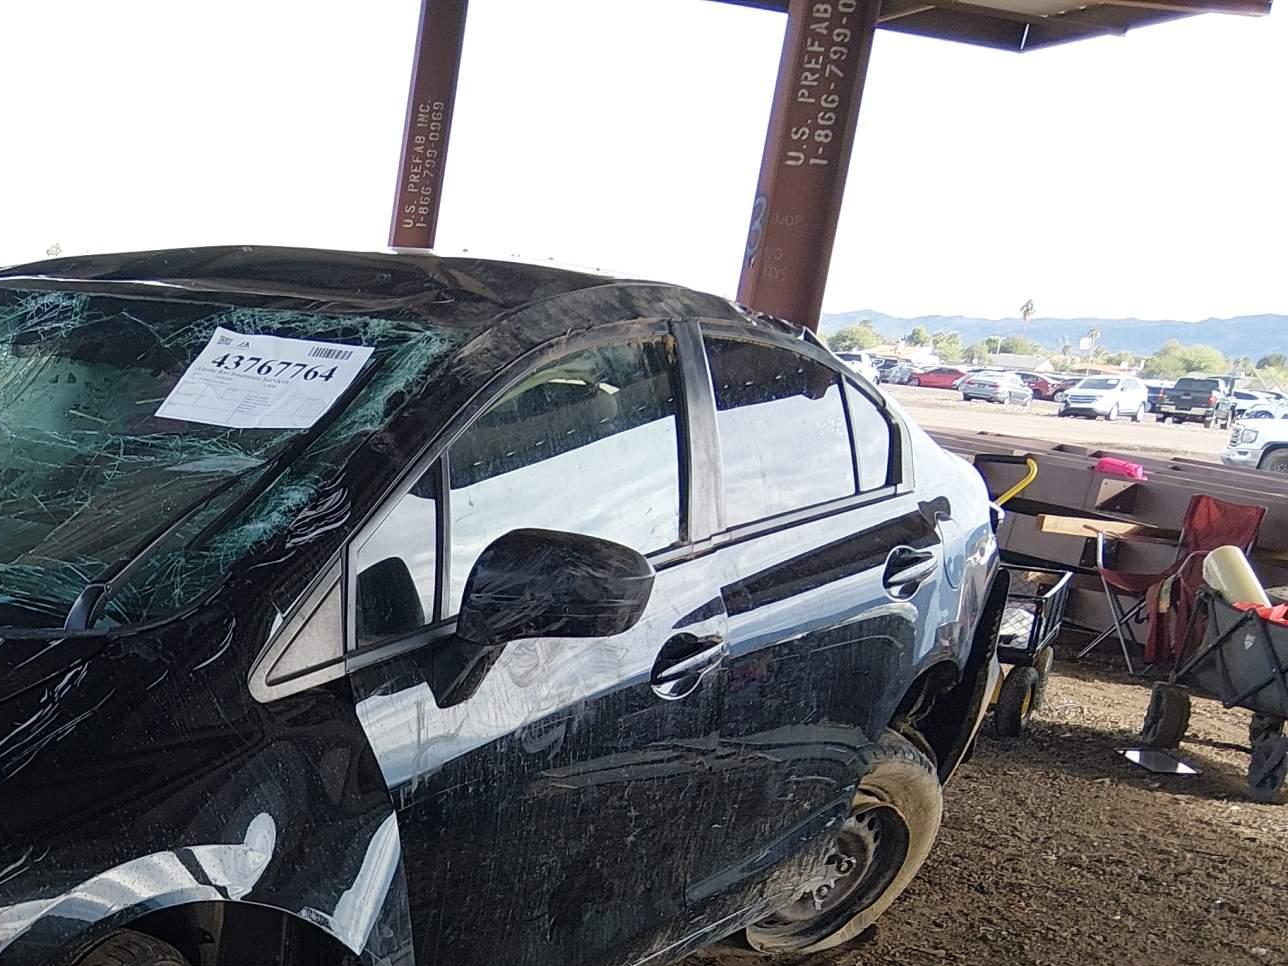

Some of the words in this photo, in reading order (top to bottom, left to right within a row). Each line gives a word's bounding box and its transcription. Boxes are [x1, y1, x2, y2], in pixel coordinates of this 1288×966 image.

[797, 3, 833, 103] PREFAB
[417, 99, 432, 127] INC.
[408, 135, 426, 192] PREFAB
[416, 101, 445, 228] 1-866-799-0969
[785, 119, 812, 166] U.S.
[402, 200, 417, 228] U.S.
[212, 353, 339, 382] 43767764
